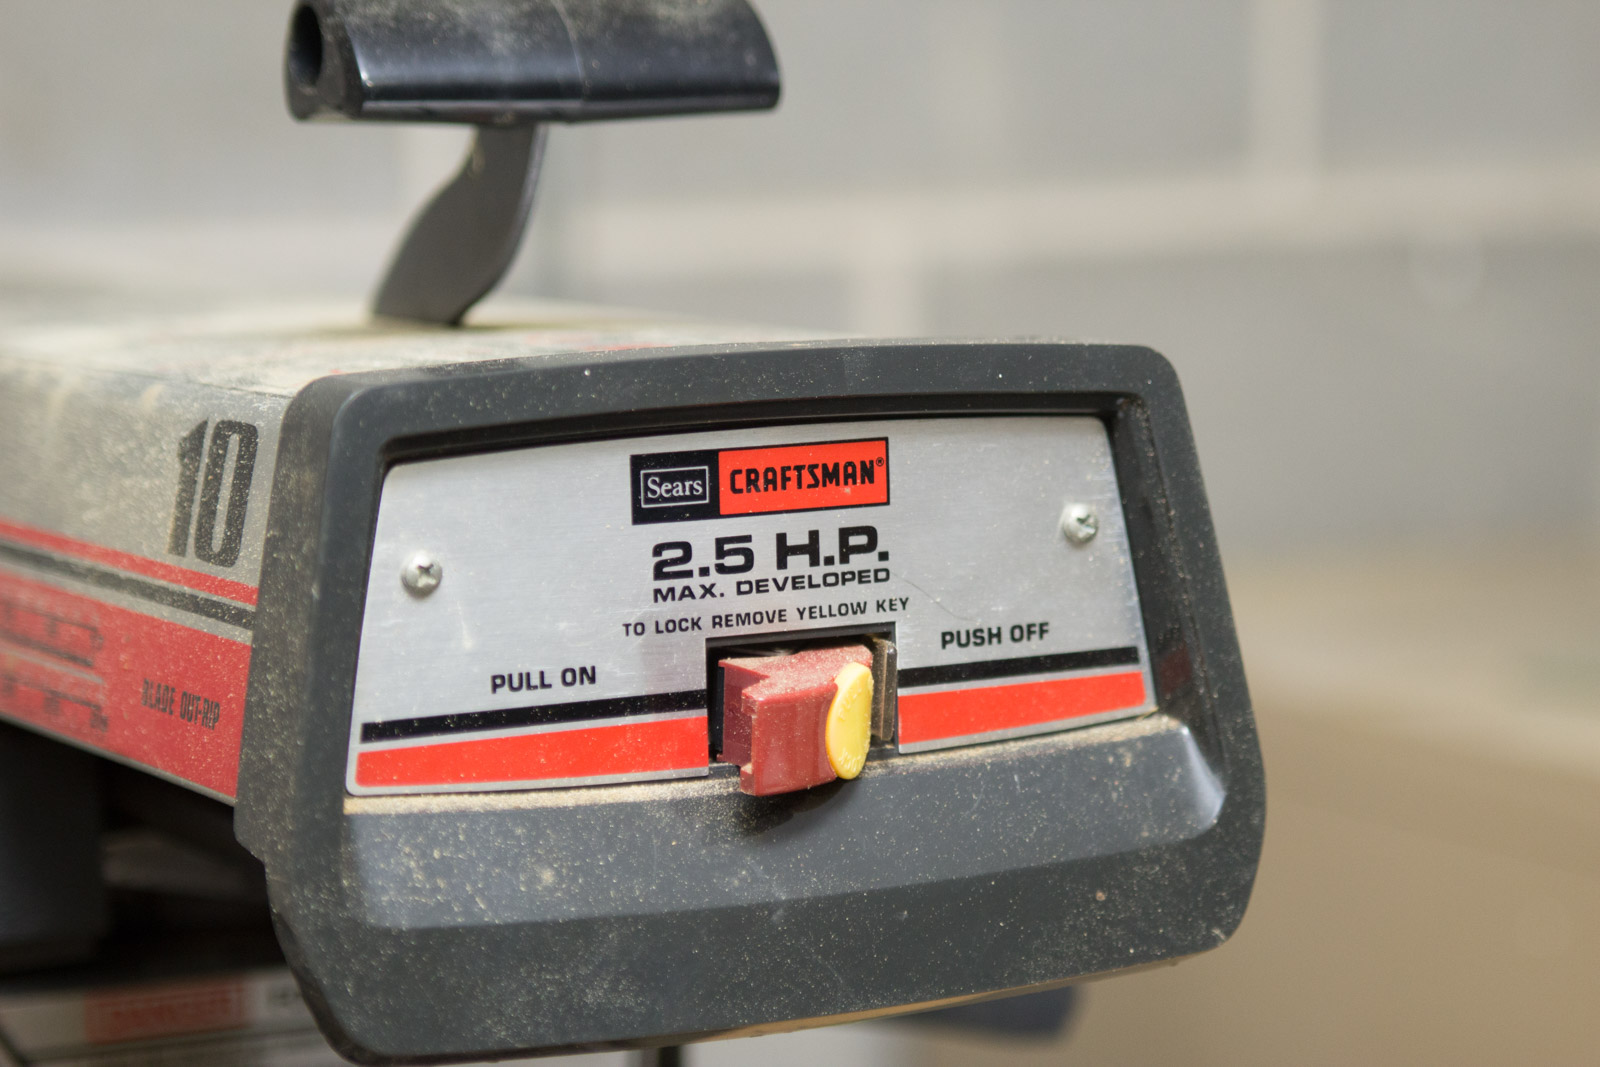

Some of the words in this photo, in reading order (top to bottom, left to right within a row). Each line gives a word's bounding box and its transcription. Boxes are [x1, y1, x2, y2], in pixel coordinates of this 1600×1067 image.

[168, 416, 259, 568] 10
[646, 476, 703, 498] Sears
[652, 534, 755, 581] 2.5
[776, 525, 889, 570] H.P.
[653, 583, 725, 604] MAX.
[736, 568, 891, 596] DEVELOPED
[622, 622, 646, 637] TO
[655, 616, 703, 635] LOCK
[711, 608, 788, 630] REMOVE
[796, 601, 868, 621] YELLOW
[876, 597, 910, 613] KEY
[941, 626, 1002, 650] PUSH
[1010, 622, 1049, 644] OFF
[141, 678, 176, 716] BLADE
[490, 670, 553, 695] PULL
[561, 665, 597, 688] ON
